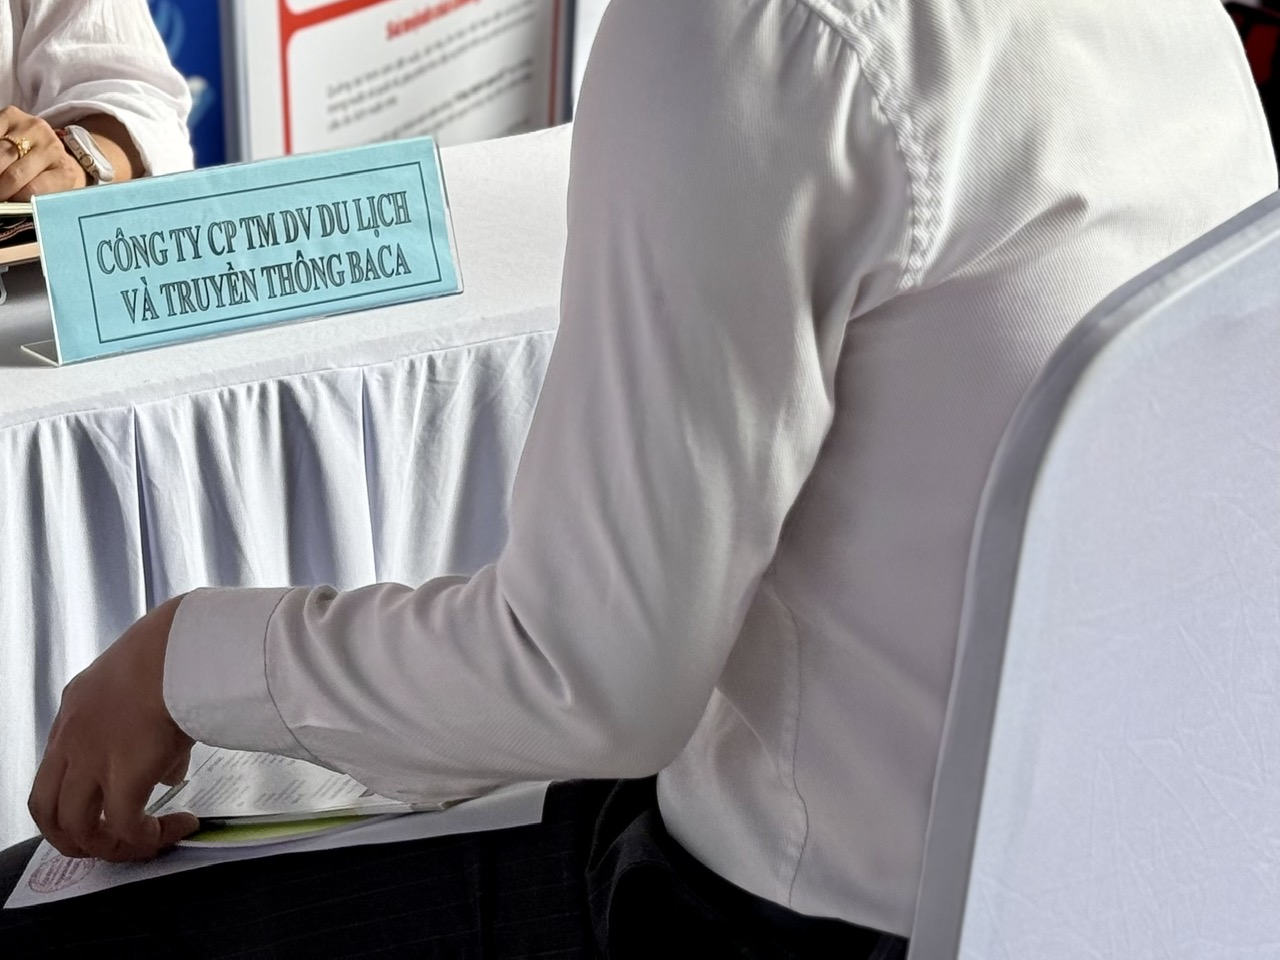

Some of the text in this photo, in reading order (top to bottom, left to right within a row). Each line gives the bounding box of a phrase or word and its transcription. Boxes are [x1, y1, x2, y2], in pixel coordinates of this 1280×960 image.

[96, 190, 412, 275] CÔNG TY CP TM DV DU LỊCH
[120, 242, 413, 324] VÀ TRUYỀN THÔNG BACA
